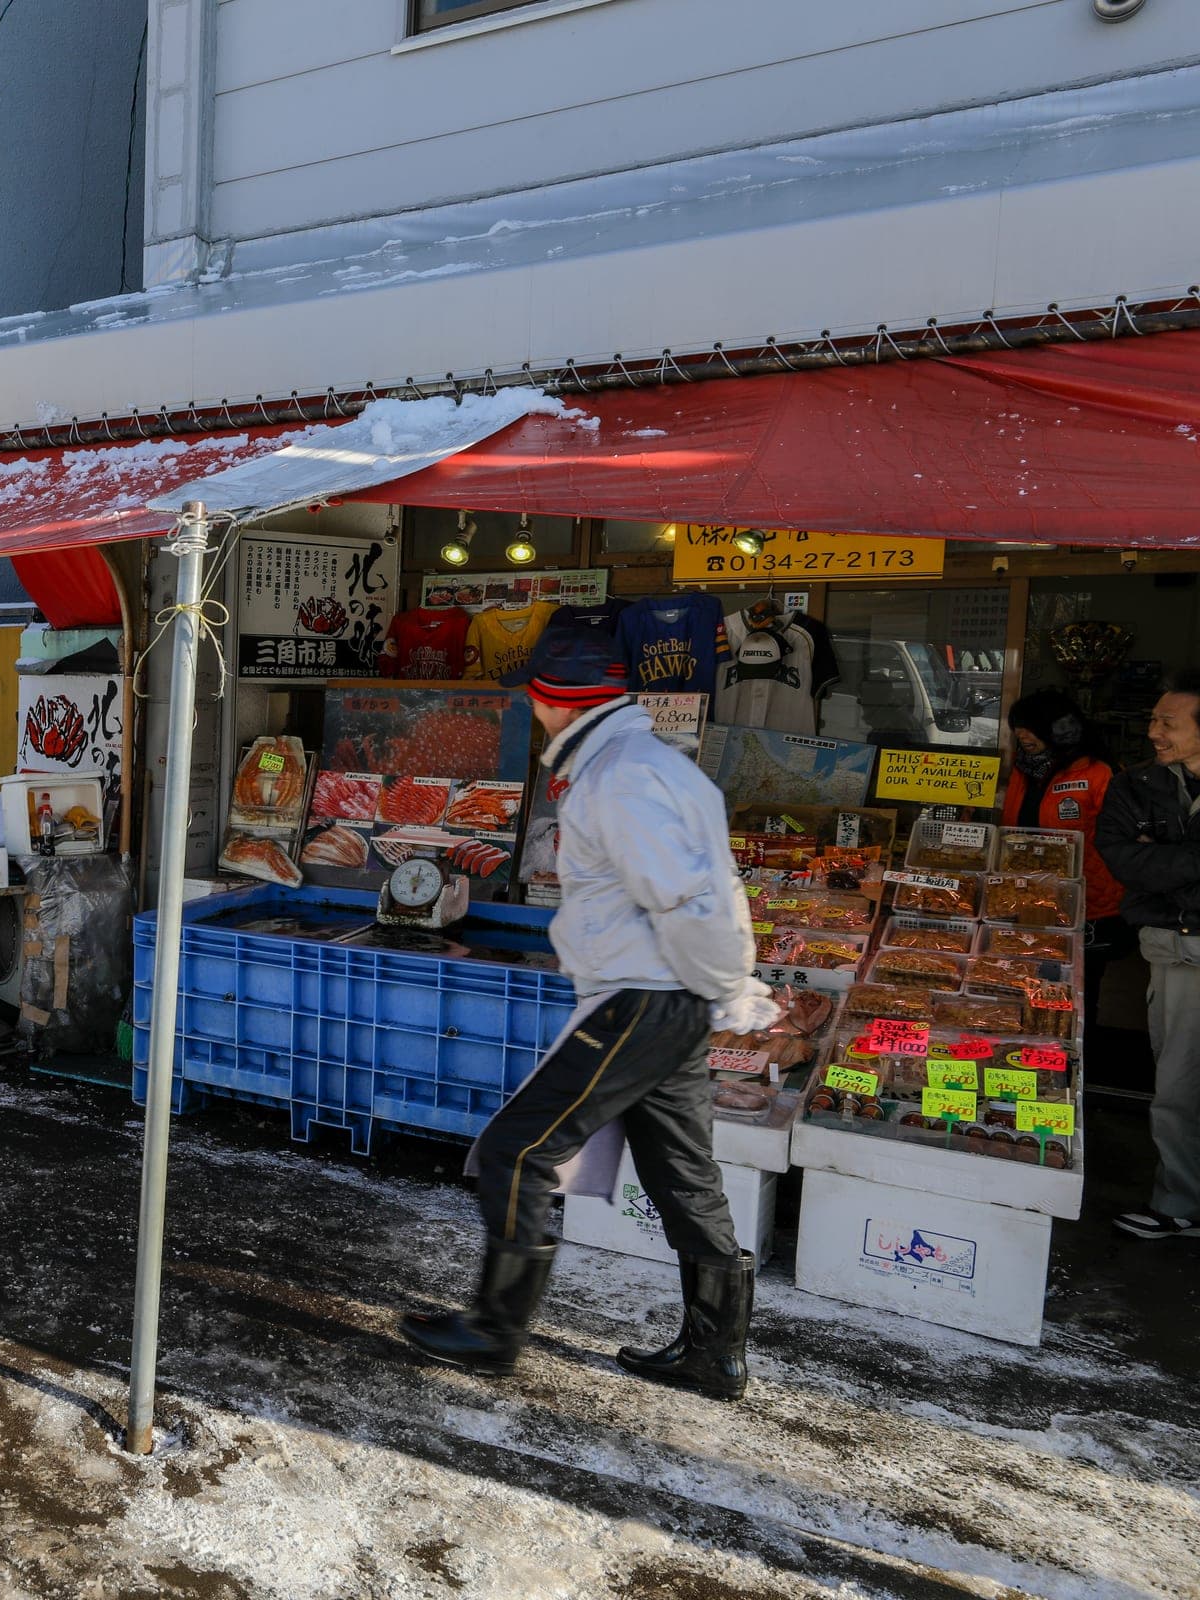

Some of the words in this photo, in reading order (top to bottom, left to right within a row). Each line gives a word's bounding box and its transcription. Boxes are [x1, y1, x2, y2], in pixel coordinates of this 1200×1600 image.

[730, 549, 915, 571] 0134-27-2173
[256, 639, 337, 665] 三角市場
[886, 753, 920, 764] THIS
[937, 757, 966, 767] SIZE
[970, 760, 981, 768] IS
[886, 765, 918, 774] ONLY
[921, 767, 982, 779] AVAILABLE
[885, 776, 908, 785] OUR
[915, 778, 958, 789] STORE
